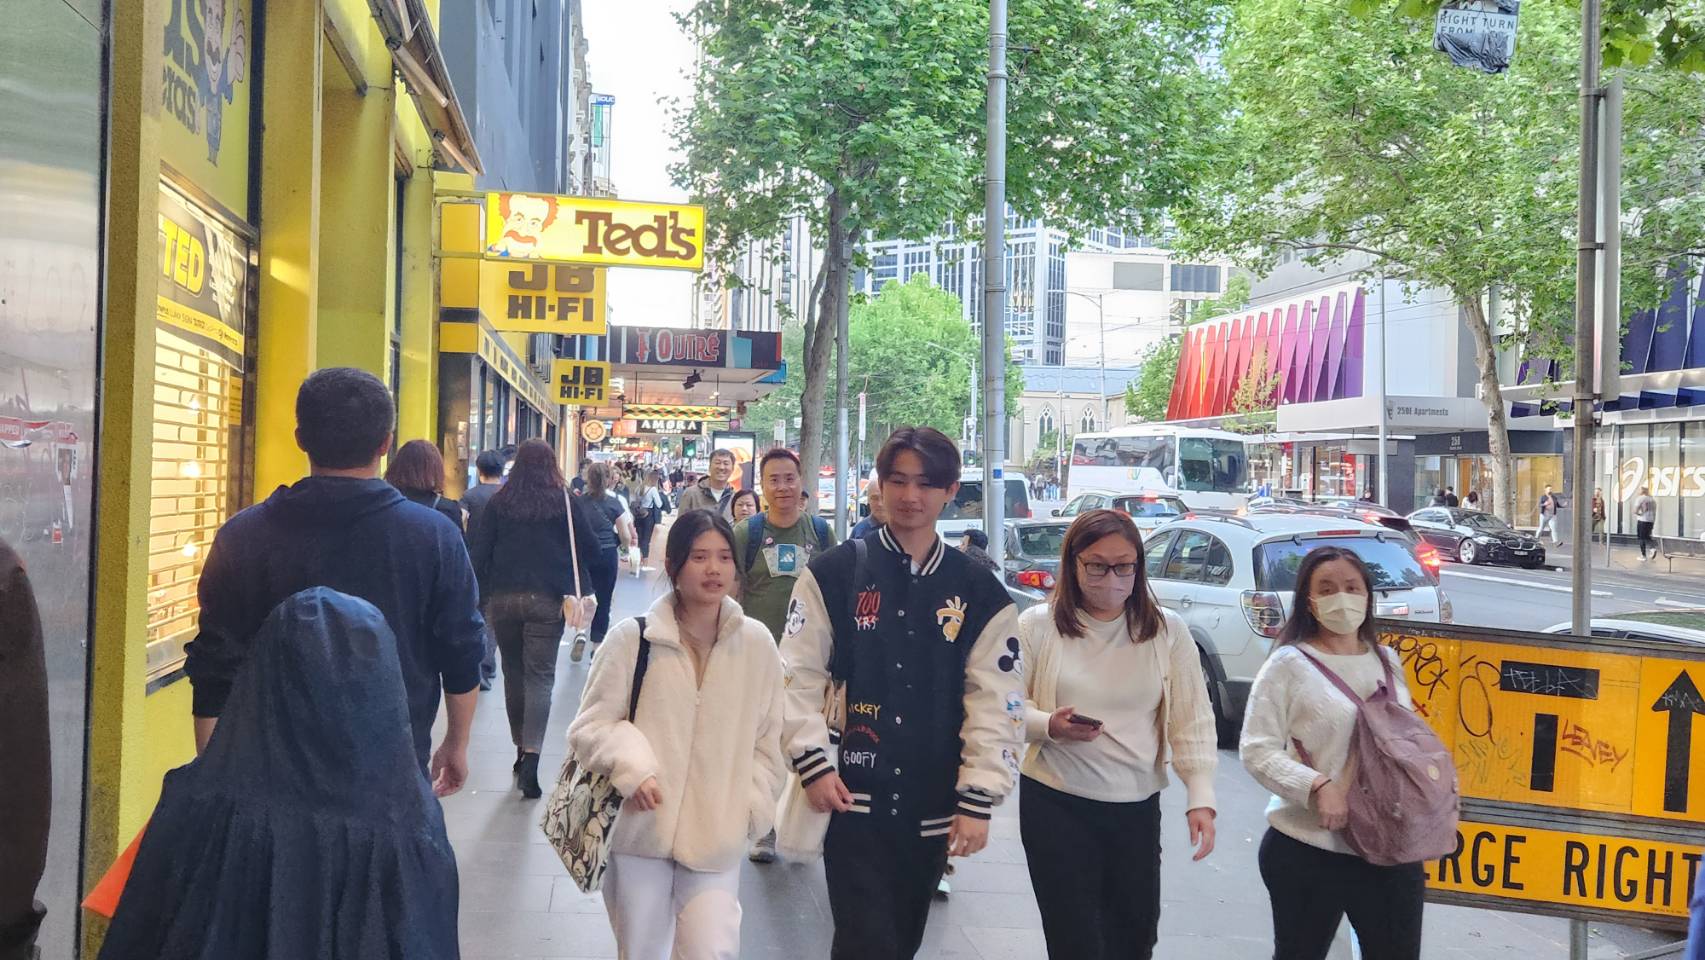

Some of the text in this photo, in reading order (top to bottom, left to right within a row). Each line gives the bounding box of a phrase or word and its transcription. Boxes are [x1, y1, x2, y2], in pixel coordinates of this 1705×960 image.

[1440, 14, 1514, 30] RIGHT TURN
[575, 210, 696, 260] Ted's
[508, 264, 595, 293] JB
[507, 294, 594, 321] HI-FI
[560, 366, 603, 386] JB
[560, 386, 603, 400] HI-FI
[1414, 407, 1448, 417] Apartments
[854, 615, 880, 631] YRS
[843, 750, 877, 768] GOOFY
